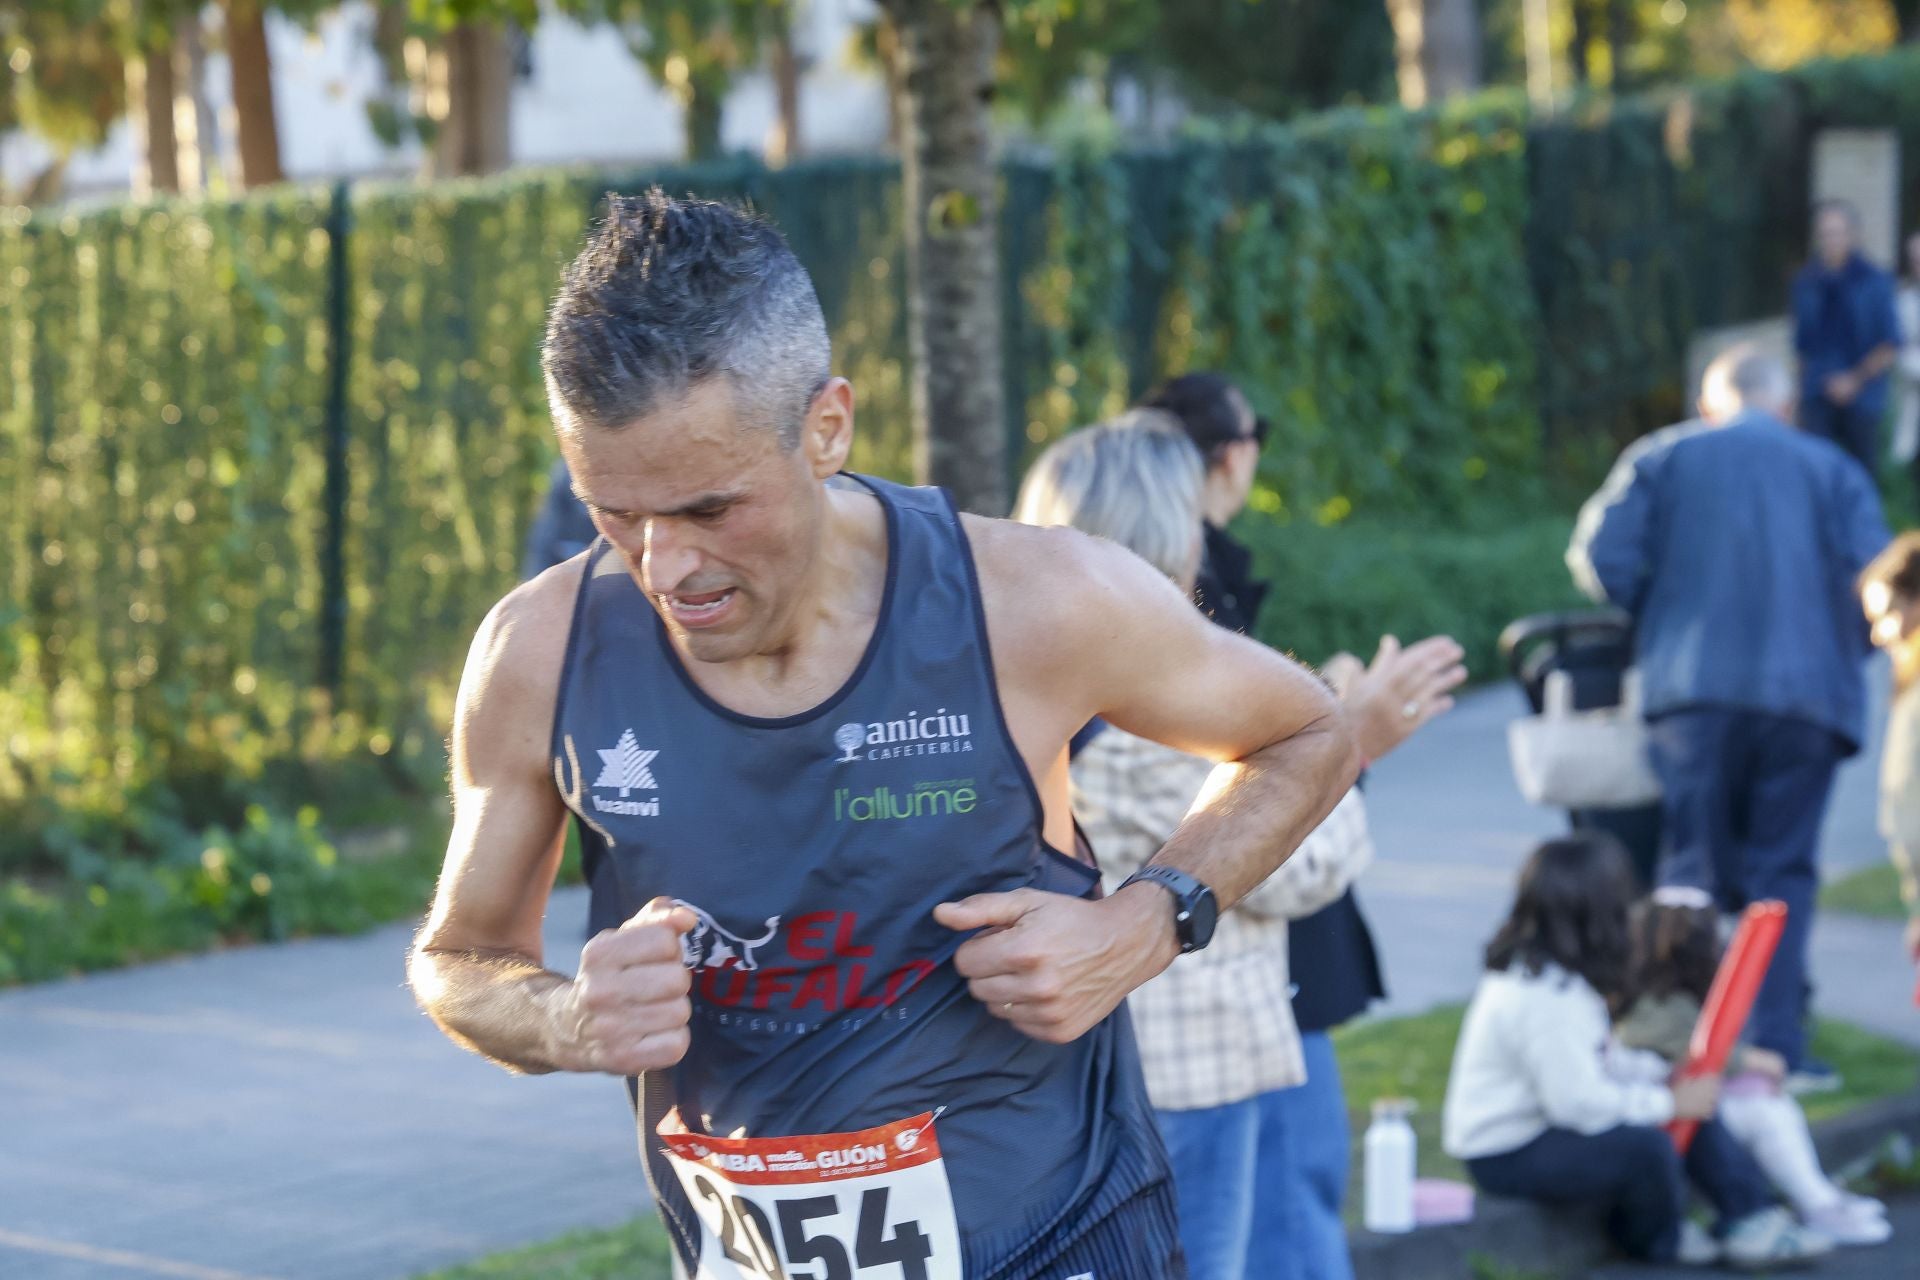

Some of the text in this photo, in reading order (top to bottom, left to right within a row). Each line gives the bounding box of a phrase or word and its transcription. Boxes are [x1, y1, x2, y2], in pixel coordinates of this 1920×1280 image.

[866, 708, 971, 745] aniciu
[867, 739, 974, 761] CAFETERÍA
[834, 787, 977, 821] l'allume
[787, 911, 875, 960] EL
[688, 957, 936, 1012] ÚFALO
[816, 1143, 887, 1168] GIJÓN
[695, 1186, 933, 1280] 2054
